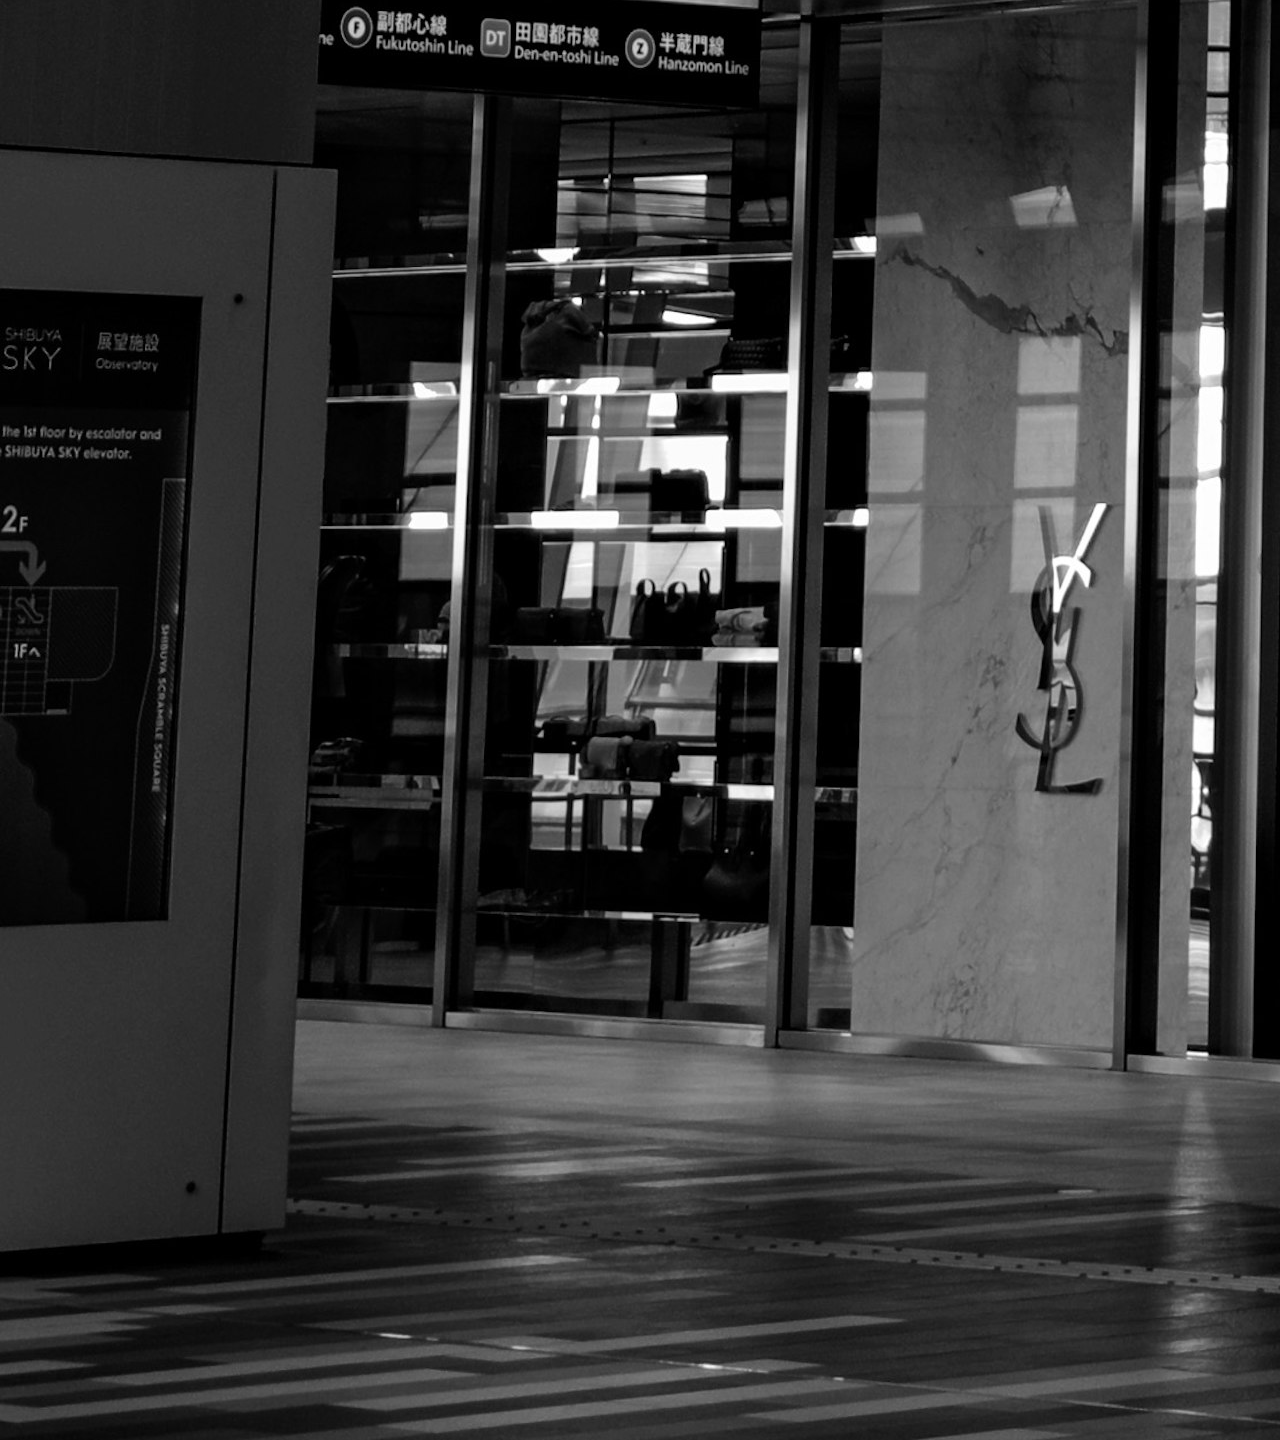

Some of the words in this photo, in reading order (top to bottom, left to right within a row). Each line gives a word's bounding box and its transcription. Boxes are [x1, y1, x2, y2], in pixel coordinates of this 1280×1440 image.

[376, 11, 448, 37] 副都心線
[515, 21, 601, 49] 田園都市線
[375, 34, 446, 55] Fukutoshin
[448, 40, 475, 56] Line
[485, 29, 507, 46] DT
[659, 32, 726, 57] 半蔵門線
[514, 45, 592, 65] Den-en-toshi
[593, 50, 620, 67] Line
[658, 56, 723, 73] Hanzomon
[724, 60, 750, 76] Line
[4, 326, 63, 343] SHIBUYA
[97, 331, 160, 353] 展望施設
[2, 345, 62, 371] SKY
[95, 357, 160, 373] Observatory
[1, 424, 21, 438] the
[23, 424, 37, 439] 1st
[40, 425, 67, 439] floor
[69, 426, 84, 442] by
[86, 428, 138, 440] escalator
[139, 428, 163, 441] and
[4, 445, 56, 459] SHIBUYA
[58, 446, 82, 459] SKY
[83, 447, 133, 460] elevator.
[1, 504, 29, 534] 2F
